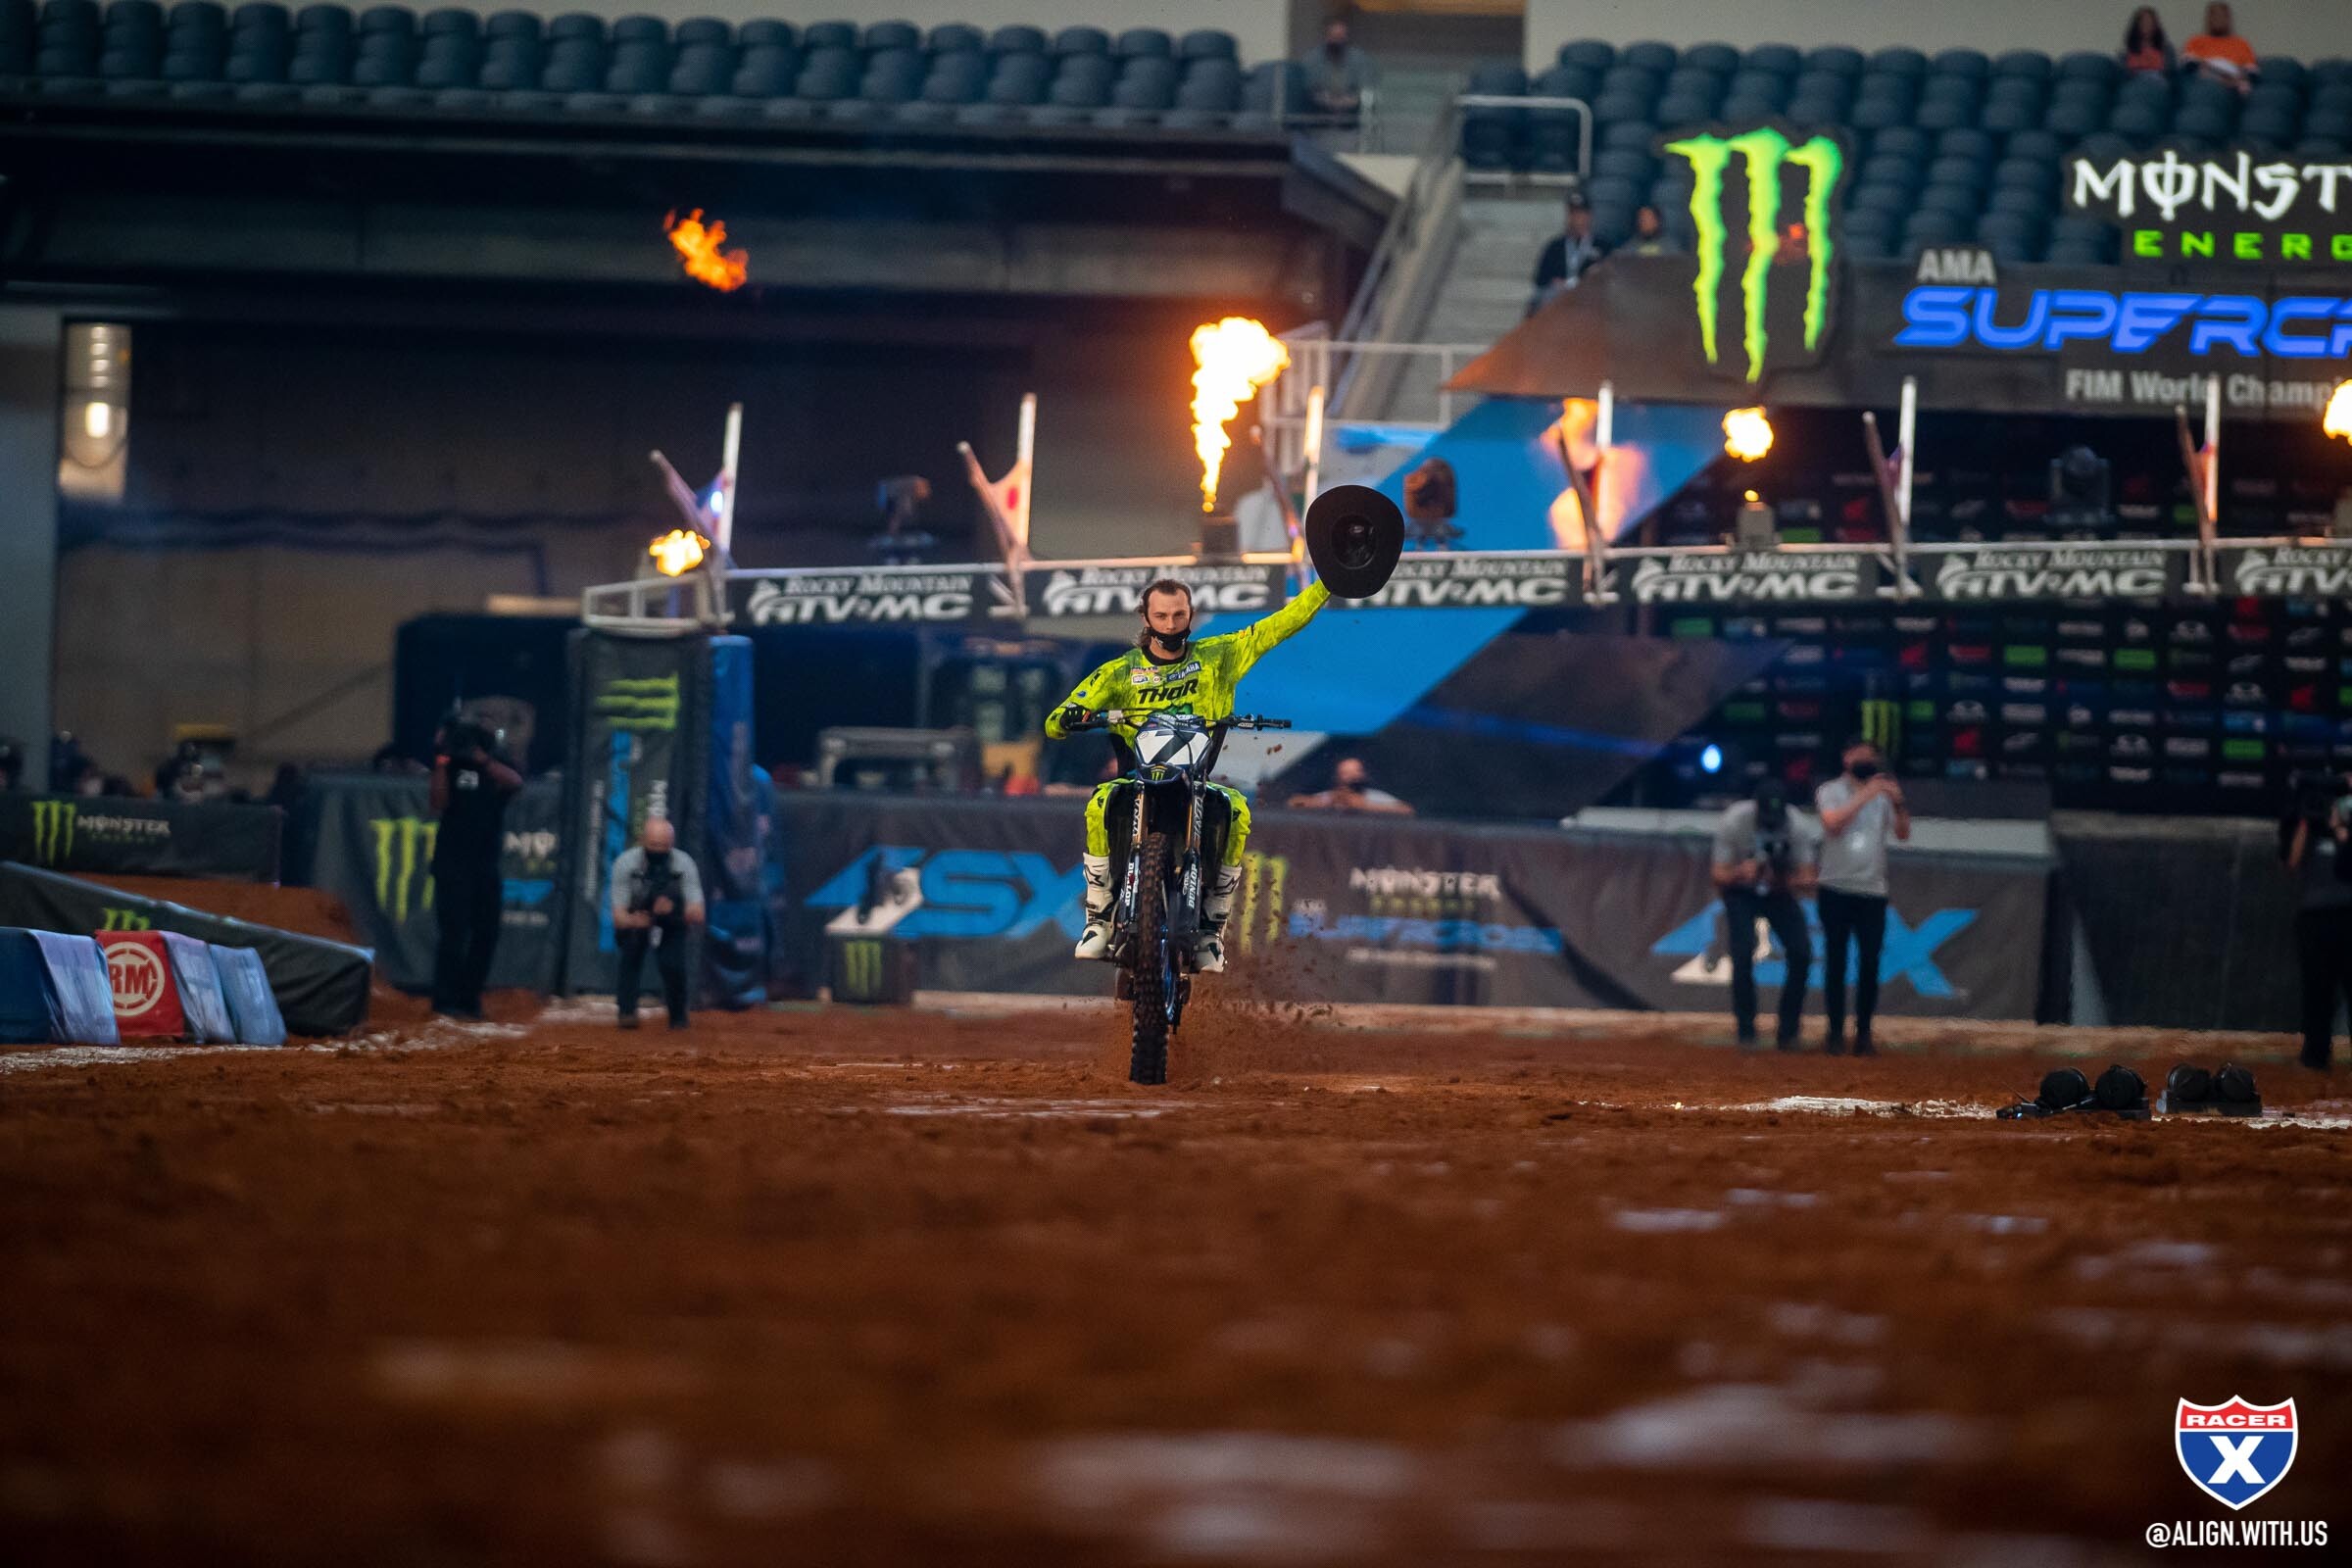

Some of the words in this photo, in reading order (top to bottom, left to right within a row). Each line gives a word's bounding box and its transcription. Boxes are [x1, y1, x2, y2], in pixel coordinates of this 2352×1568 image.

[1918, 249, 1996, 284] AMA
[2066, 369, 2123, 398] FIM
[1975, 549, 2046, 568] ROCKY
[2047, 548, 2165, 568] MOUNTAIN
[1138, 678, 1199, 705] THOR
[1150, 730, 1198, 764] 7
[1188, 863, 1199, 909] DUNLOP
